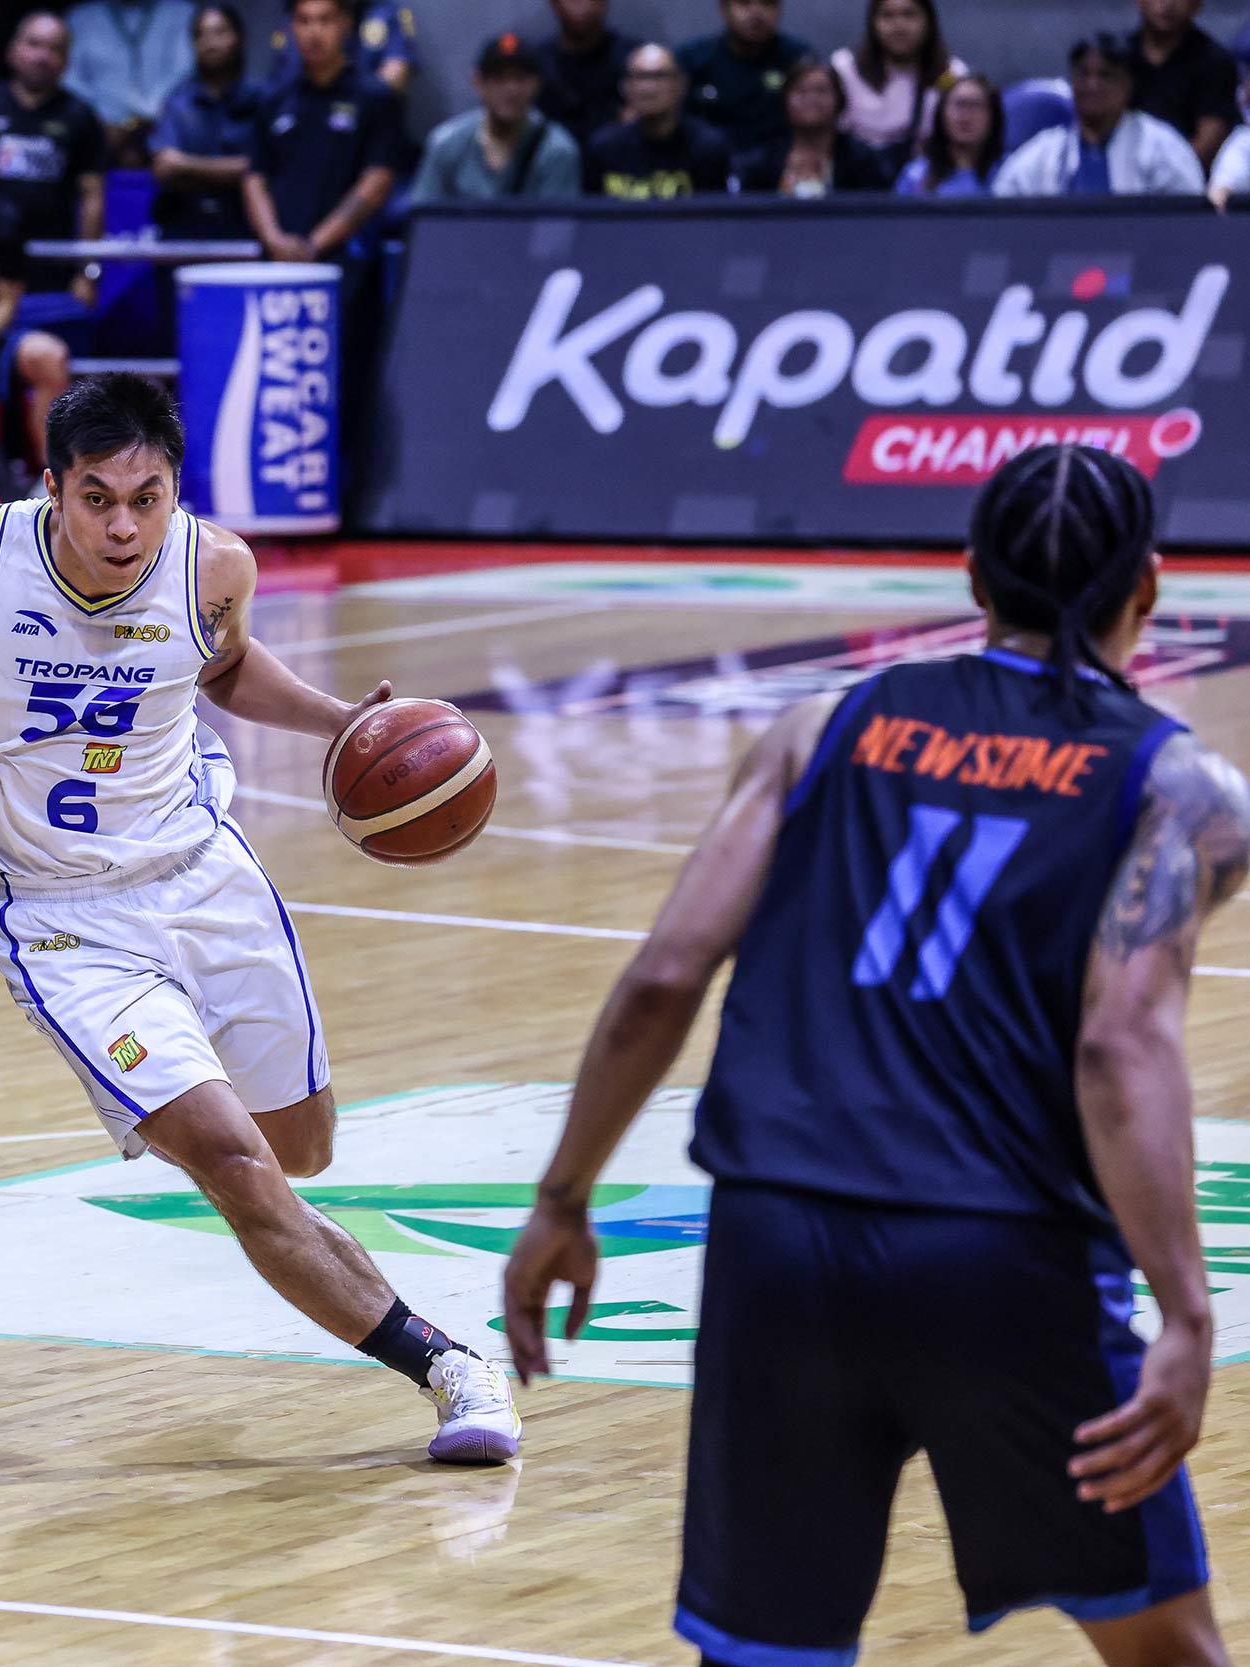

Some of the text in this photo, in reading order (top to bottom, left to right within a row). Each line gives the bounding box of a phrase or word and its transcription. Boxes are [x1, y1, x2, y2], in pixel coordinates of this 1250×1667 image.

[259, 290, 300, 492] SWEAT
[487, 265, 1230, 449] Kapatid
[297, 290, 330, 510] POCARI
[11, 622, 40, 636] ANTA
[15, 657, 156, 683] TROPANG
[81, 745, 128, 771] TNT
[852, 714, 1110, 797] NEWSOME
[47, 779, 98, 834] 6
[852, 804, 1030, 1002] 11
[110, 1031, 142, 1073] TNT
